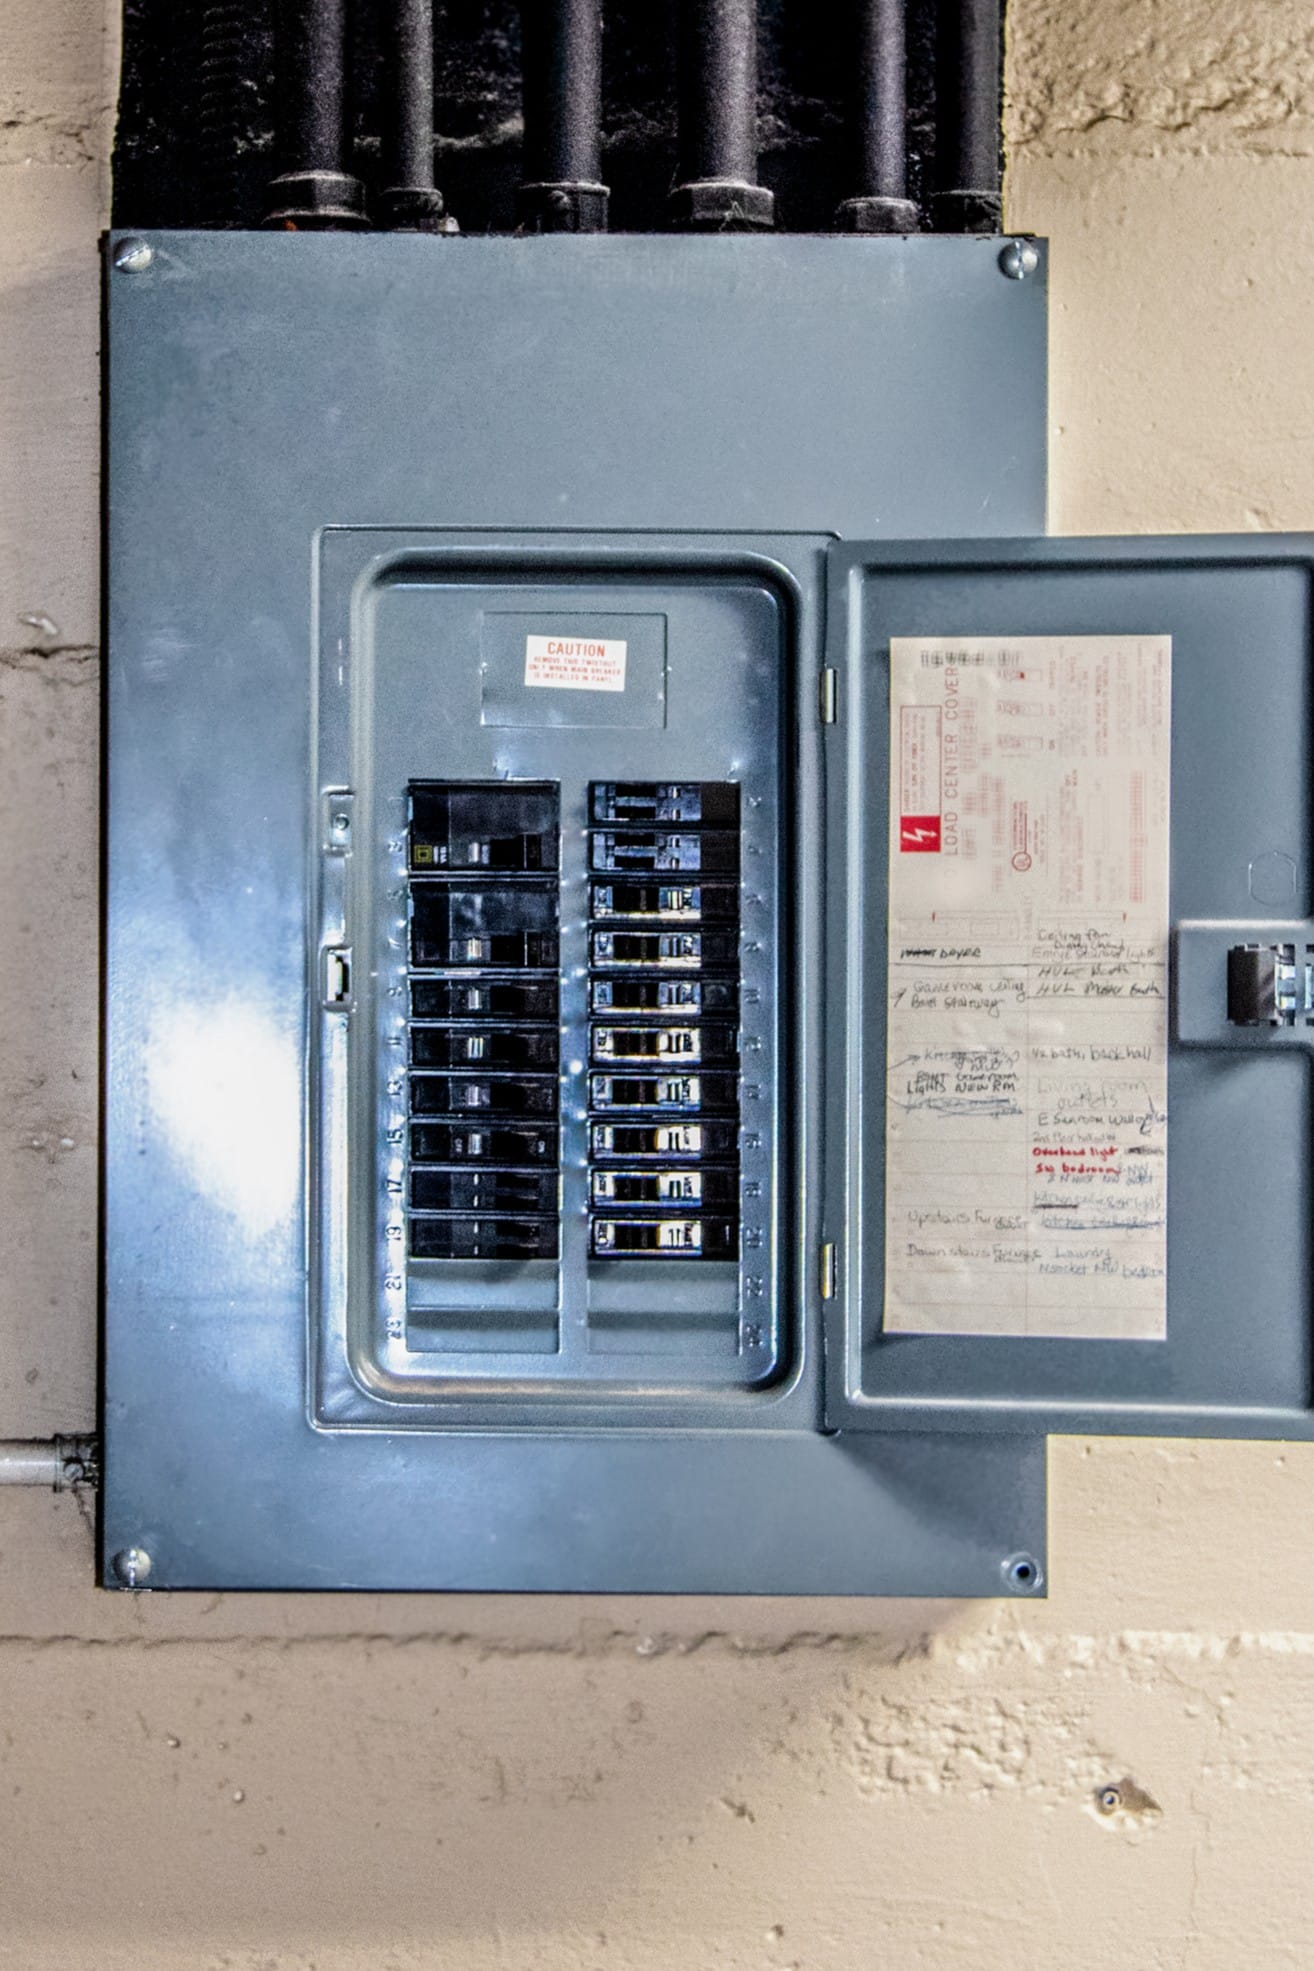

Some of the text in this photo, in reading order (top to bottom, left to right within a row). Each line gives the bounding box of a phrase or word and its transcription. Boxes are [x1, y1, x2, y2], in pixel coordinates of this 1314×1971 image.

[547, 641, 606, 657] CAUTION
[945, 667, 958, 856] LOAD CENTER COVER
[386, 1128, 402, 1145] 15
[387, 1179, 401, 1194] 17
[386, 1225, 401, 1241] 19
[385, 1272, 401, 1290] 21
